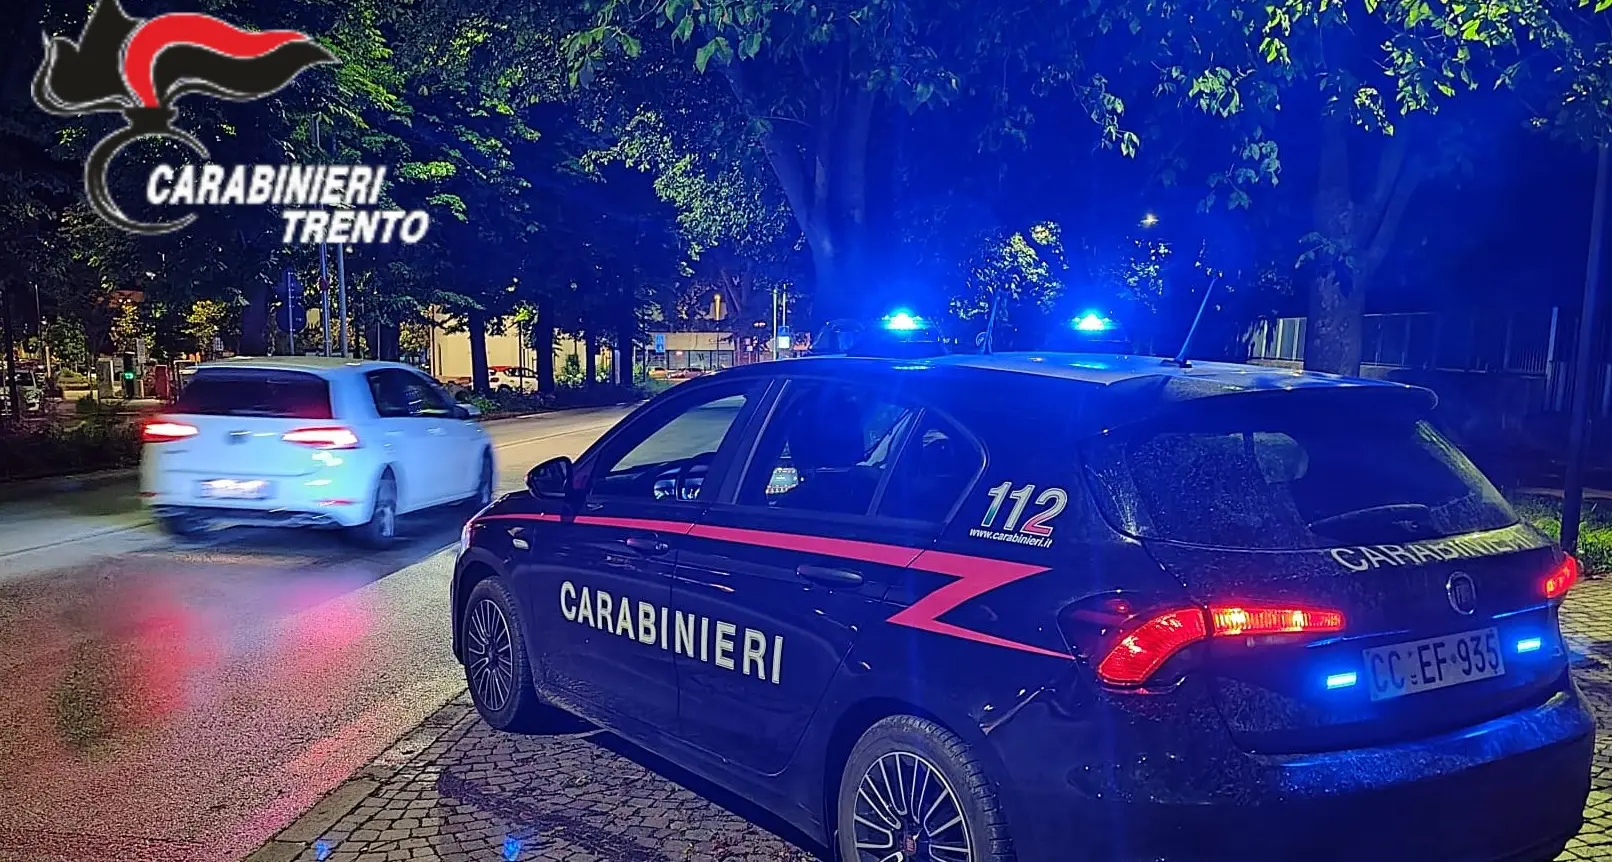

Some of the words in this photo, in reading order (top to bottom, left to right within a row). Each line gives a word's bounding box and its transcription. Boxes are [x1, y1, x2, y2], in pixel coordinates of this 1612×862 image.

[981, 481, 1068, 537] 112
[969, 527, 1053, 549] www.carabinieri.it
[560, 580, 784, 685] CARABINIERI
